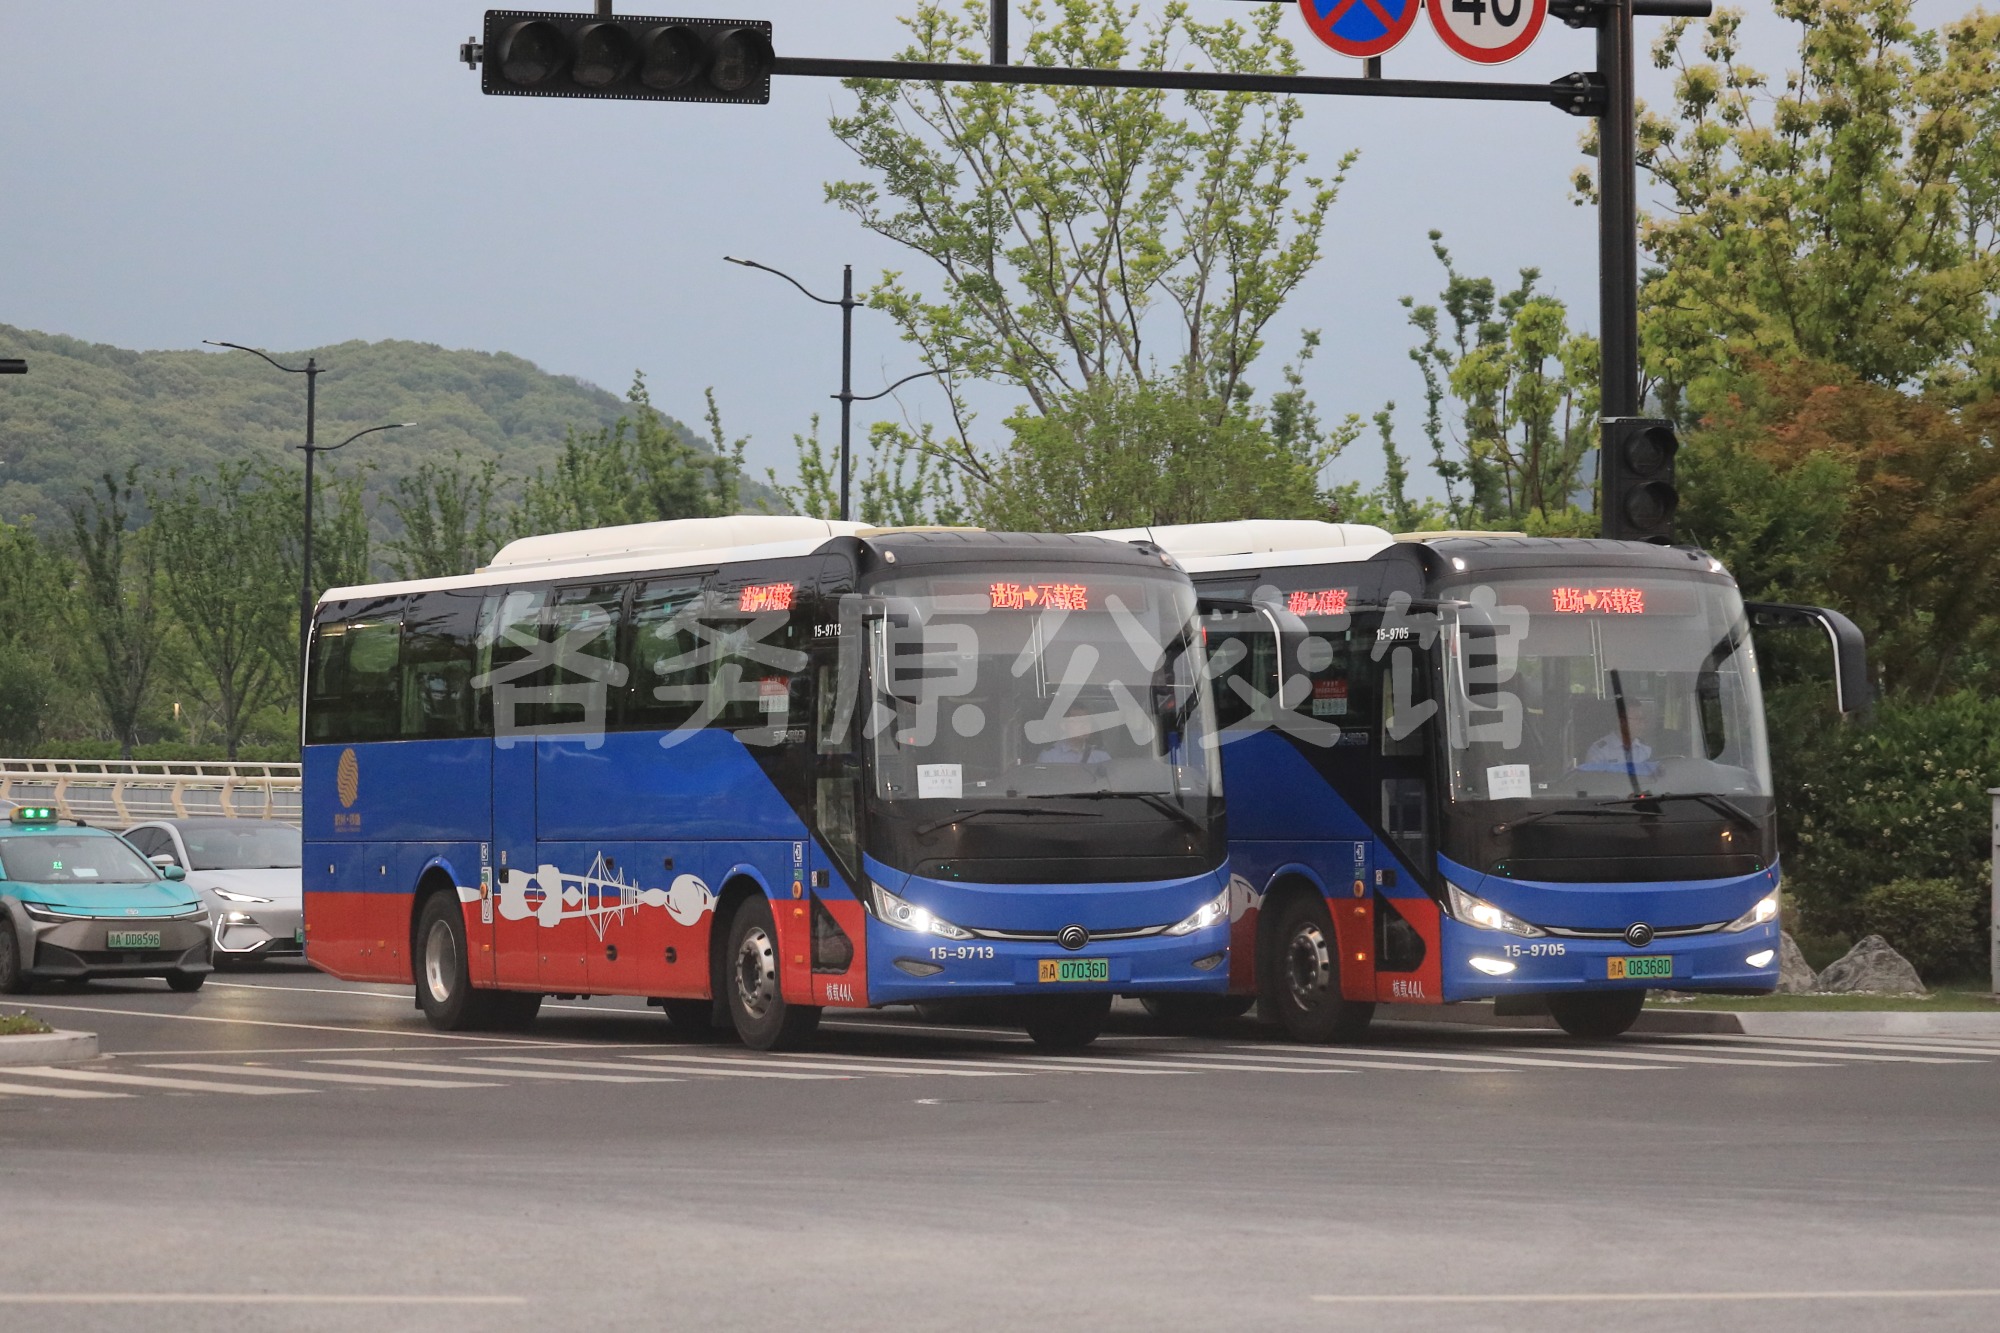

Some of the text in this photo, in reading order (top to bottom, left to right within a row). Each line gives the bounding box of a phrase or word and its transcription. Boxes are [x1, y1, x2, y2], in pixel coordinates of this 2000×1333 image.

[814, 623, 842, 638] 15-9713
[1376, 627, 1409, 641] 15-9705
[929, 946, 994, 960] 15-9713
[1503, 943, 1566, 957] 15-9705
